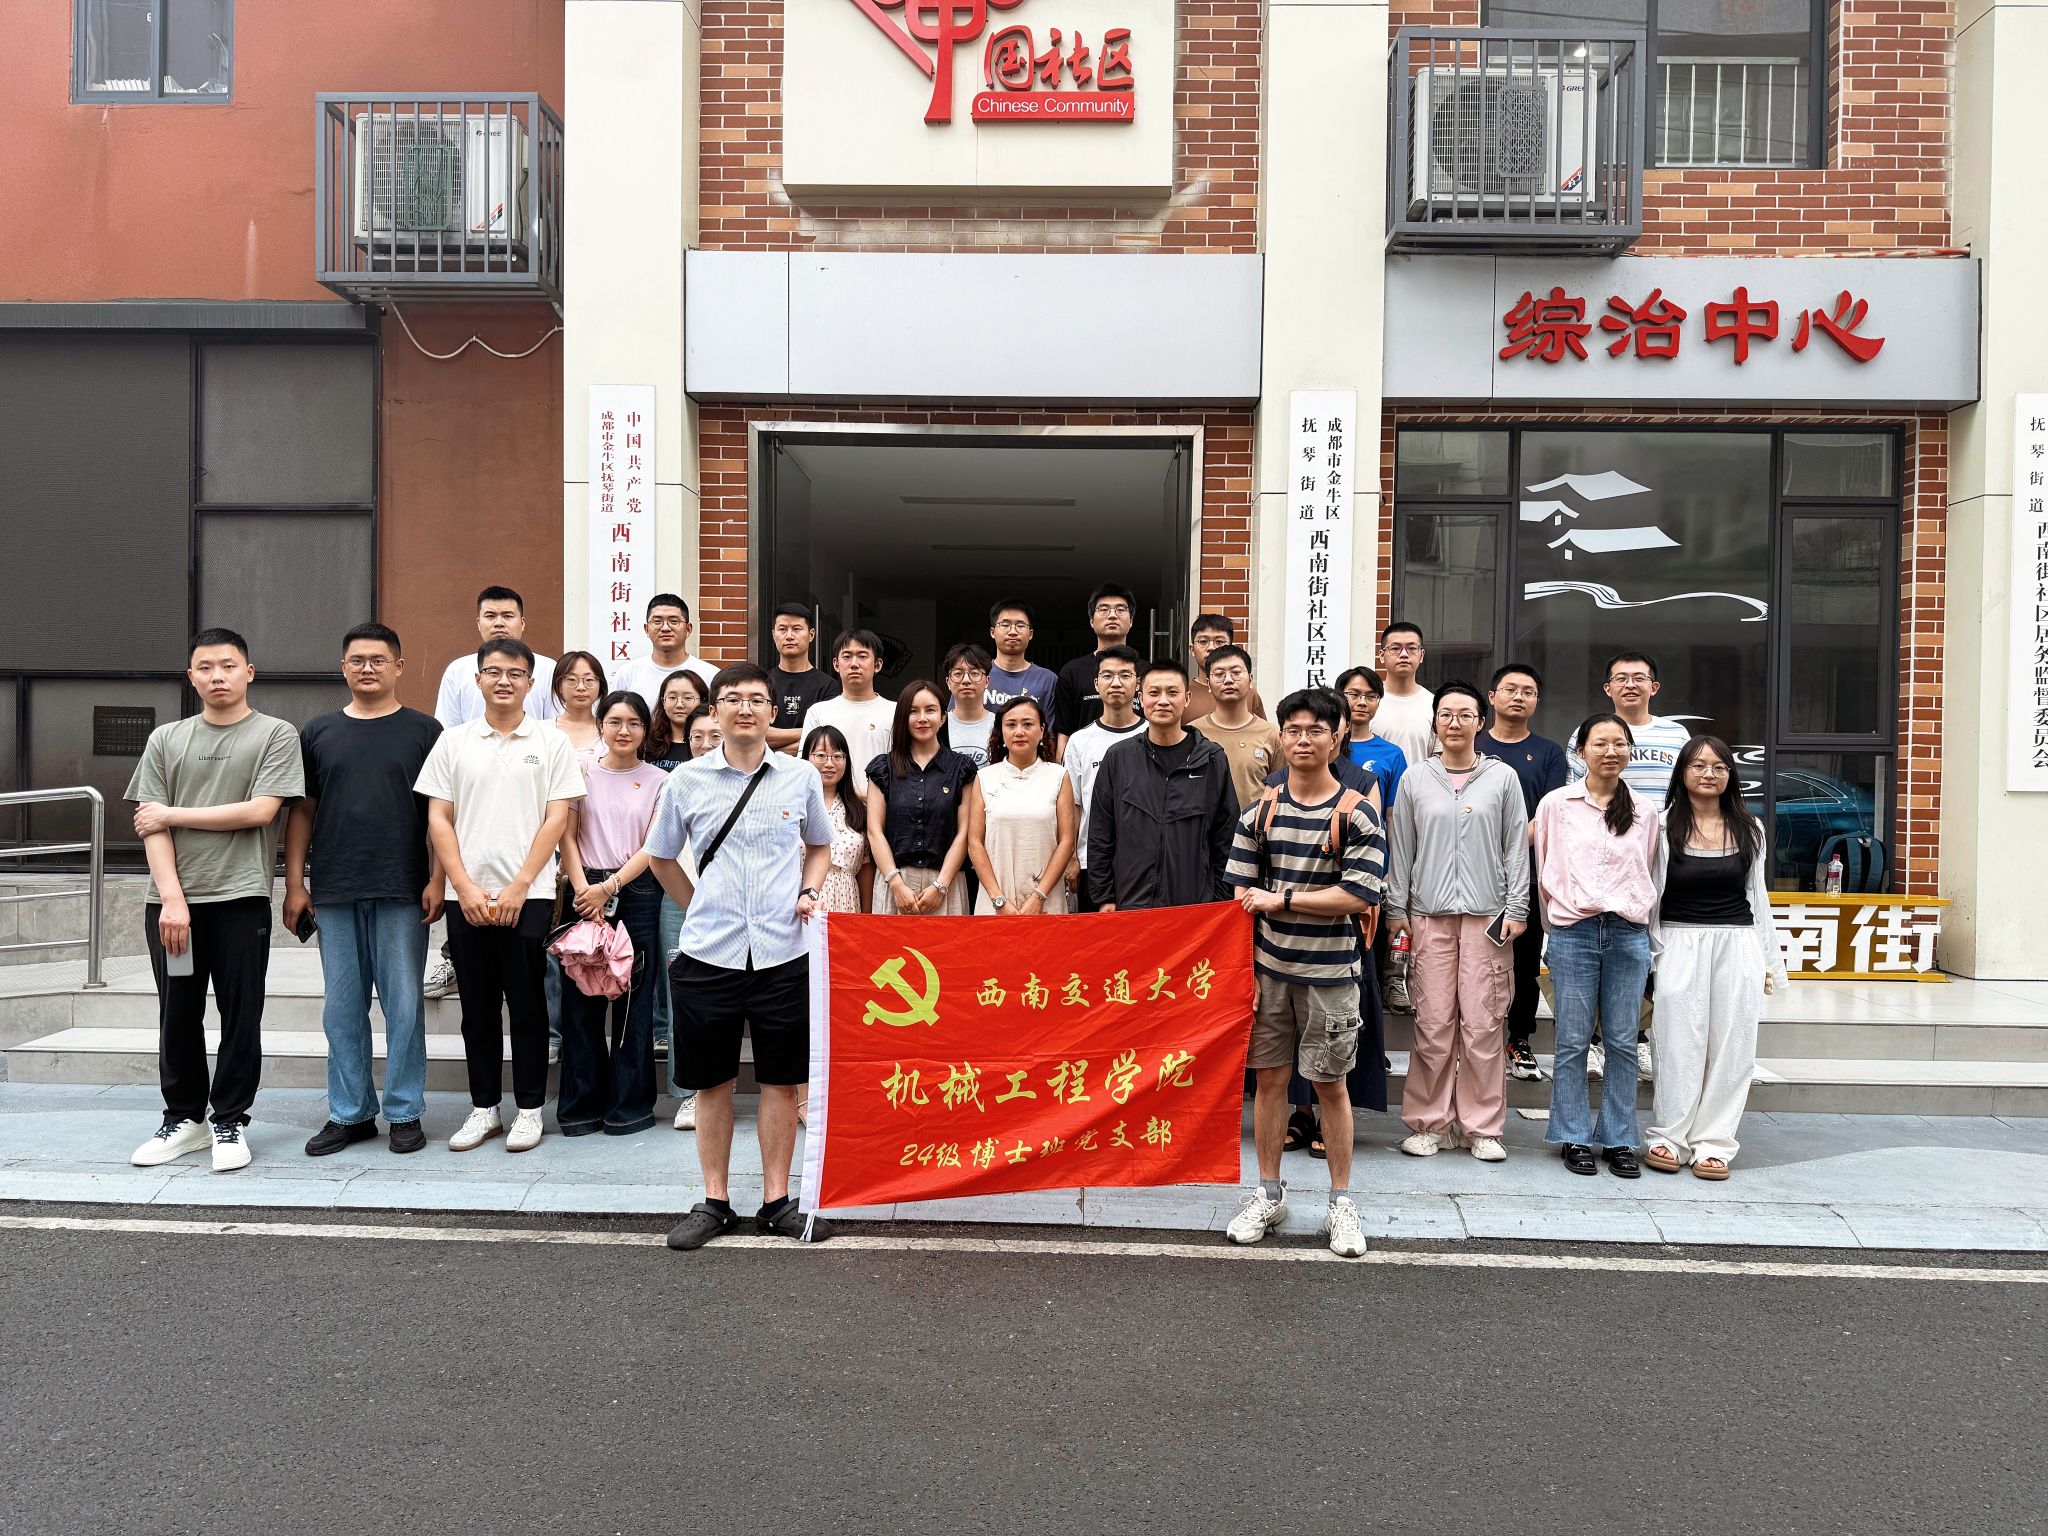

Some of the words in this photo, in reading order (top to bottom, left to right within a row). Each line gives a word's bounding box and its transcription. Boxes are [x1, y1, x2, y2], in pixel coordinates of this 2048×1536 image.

[978, 98, 1039, 113] Chinese
[1044, 98, 1129, 116] Community
[1499, 286, 1886, 365] 综治中心
[601, 410, 615, 513] 成都市金牛区抚琴街道
[626, 411, 642, 513] 中国共产党
[1299, 417, 1317, 520] 抚琴街道
[1325, 417, 1342, 520] 成都市金牛区
[2028, 416, 2046, 513] 抚琴街道
[610, 522, 632, 684] 西南街社区
[1305, 528, 1330, 689] 西南街社区居民
[975, 957, 1217, 1008] 西南交通大学
[1771, 904, 1942, 974] 南街
[880, 1048, 1197, 1113] 机械工程学院
[899, 1115, 1173, 1169] 24级博士班党支部
